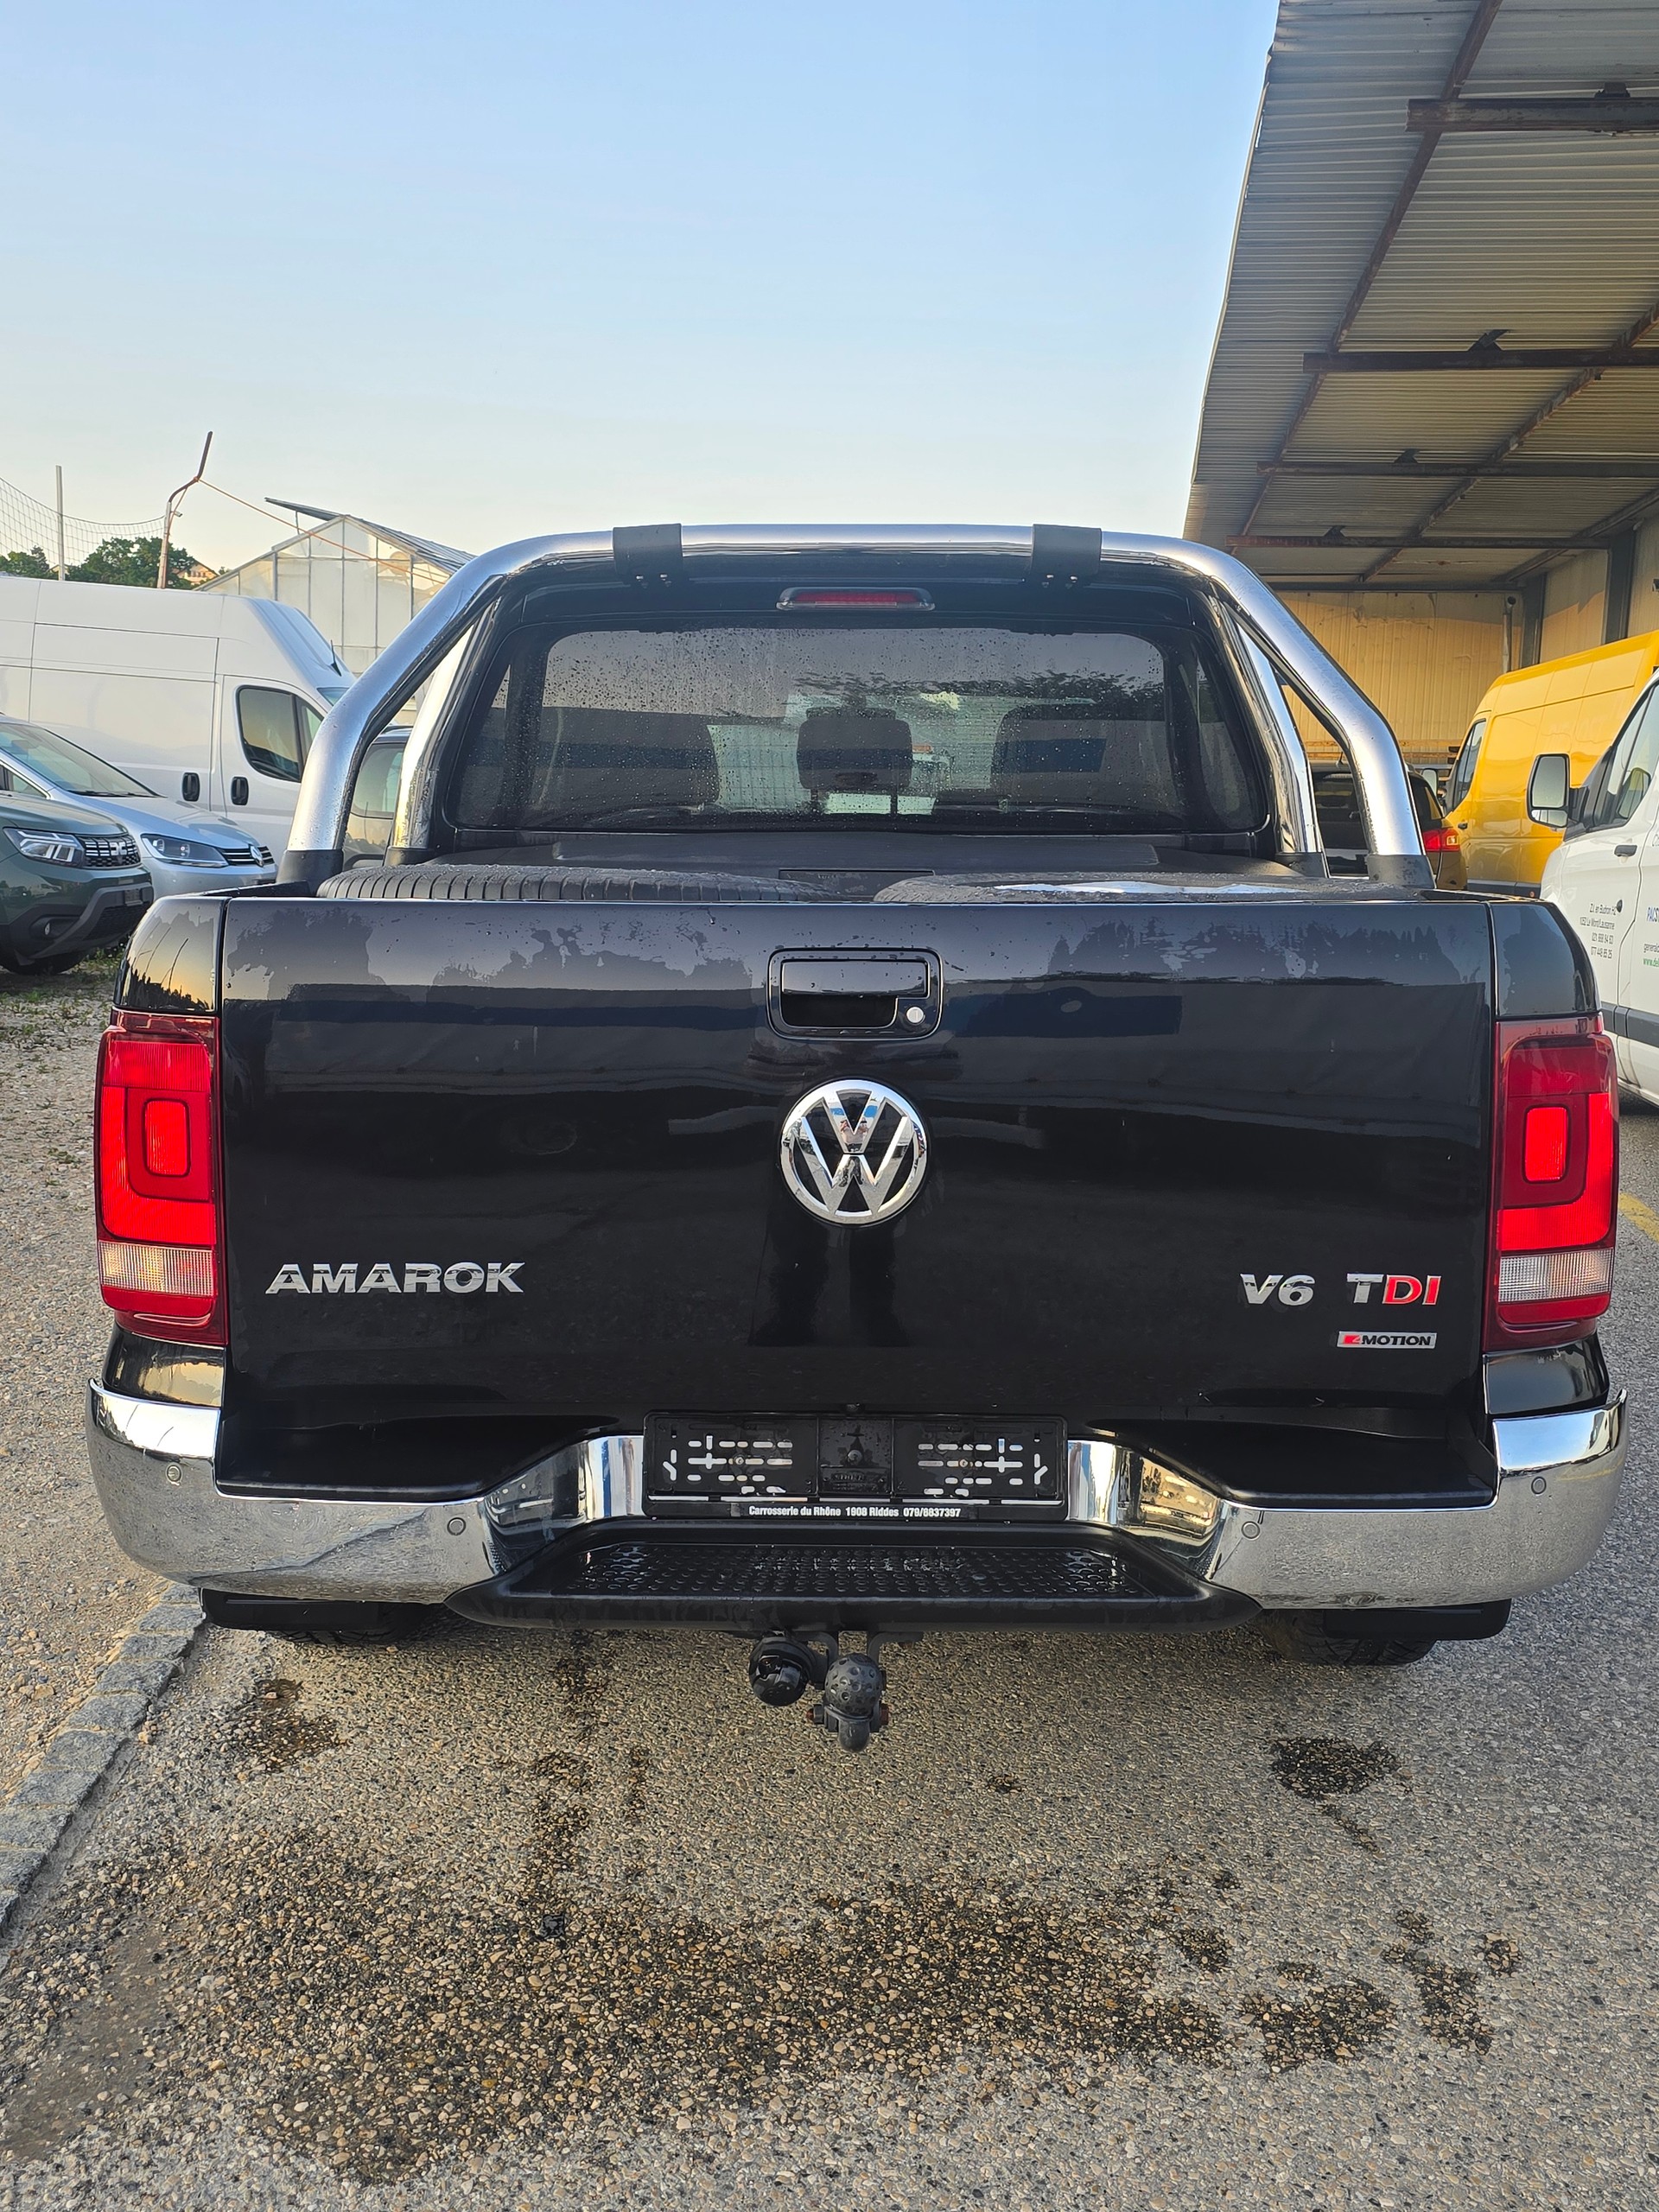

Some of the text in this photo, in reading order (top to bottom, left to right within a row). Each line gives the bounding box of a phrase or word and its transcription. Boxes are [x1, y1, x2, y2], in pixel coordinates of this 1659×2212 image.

[264, 1262, 525, 1294] AMAROK
[1239, 1273, 1442, 1306] V6 TDI
[748, 1505, 799, 1516] Carrosserie
[800, 1506, 812, 1516] du
[813, 1506, 842, 1516] Rhône
[845, 1506, 868, 1516] 1908
[868, 1506, 899, 1517] Riddes
